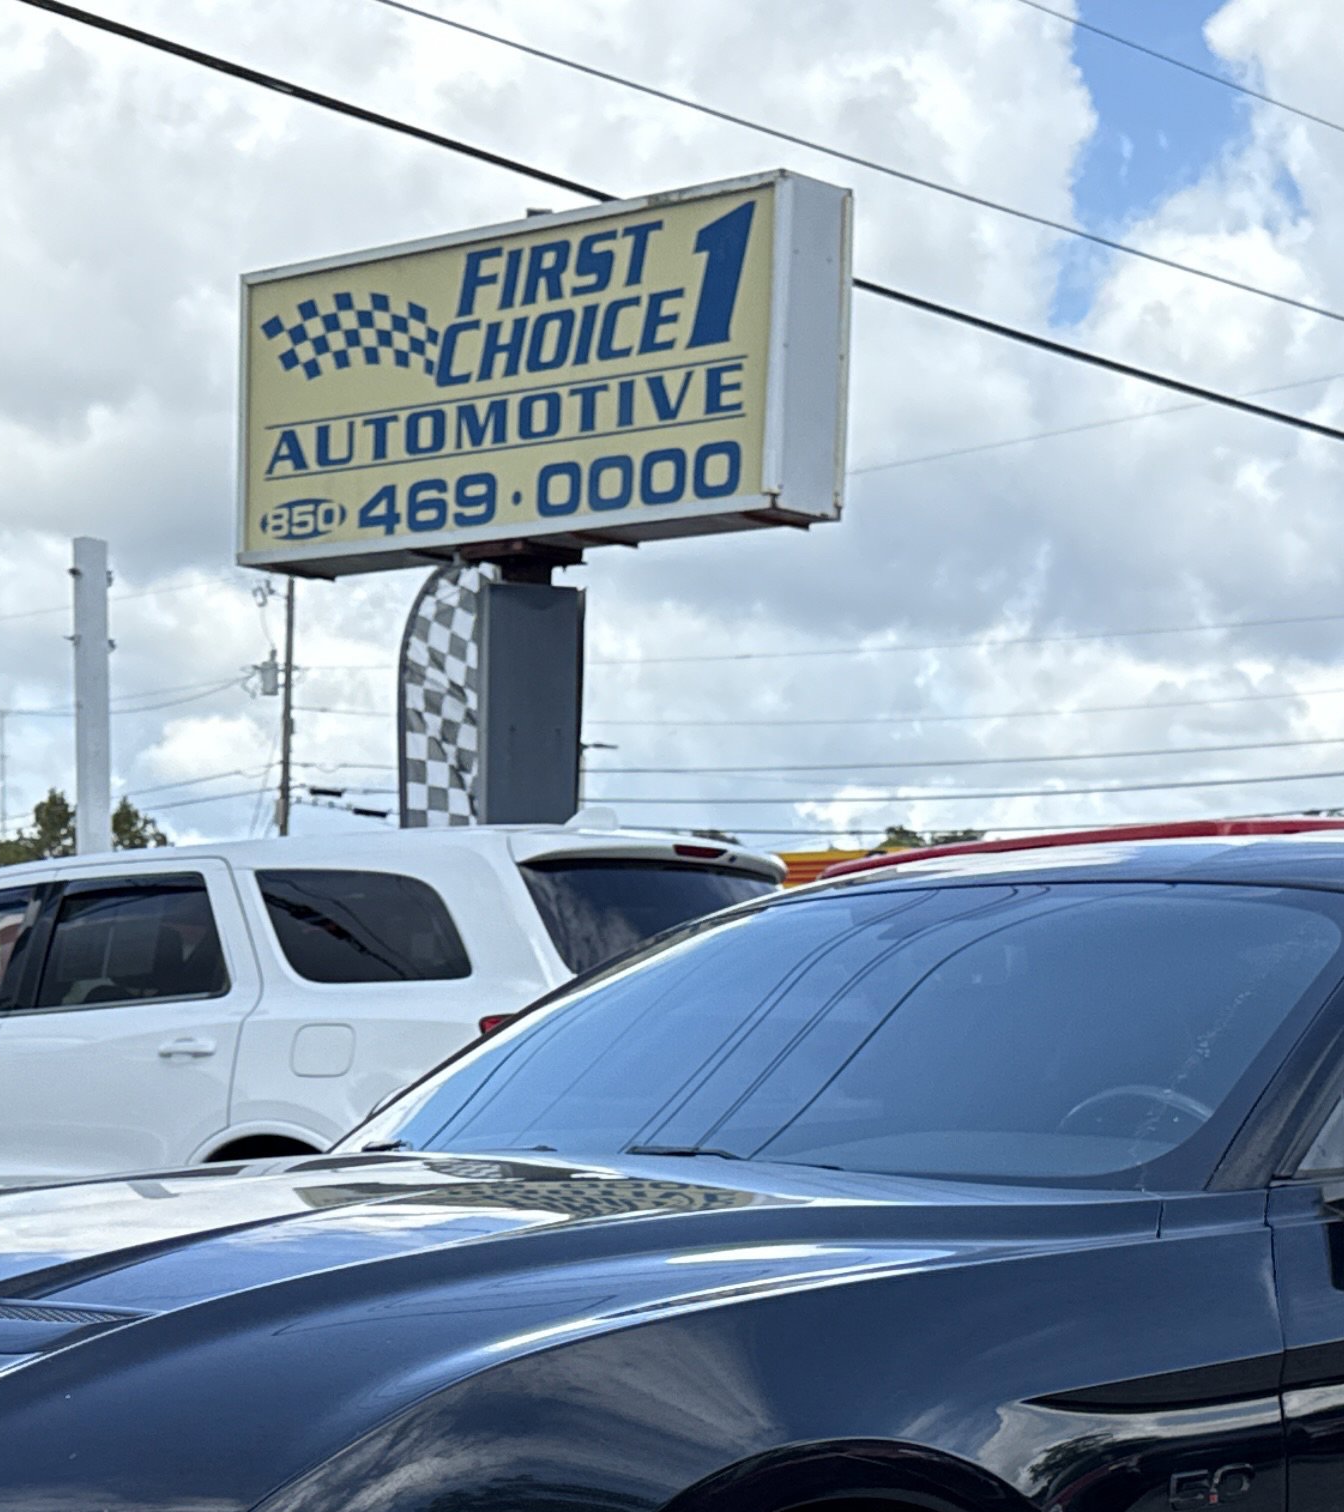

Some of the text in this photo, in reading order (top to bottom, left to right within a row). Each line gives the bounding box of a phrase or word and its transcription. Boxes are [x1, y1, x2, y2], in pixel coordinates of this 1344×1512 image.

[455, 219, 664, 319] FIRST
[685, 199, 756, 350] 1
[435, 287, 686, 388] CHOICE
[264, 362, 744, 476] AUTOMOTIVE
